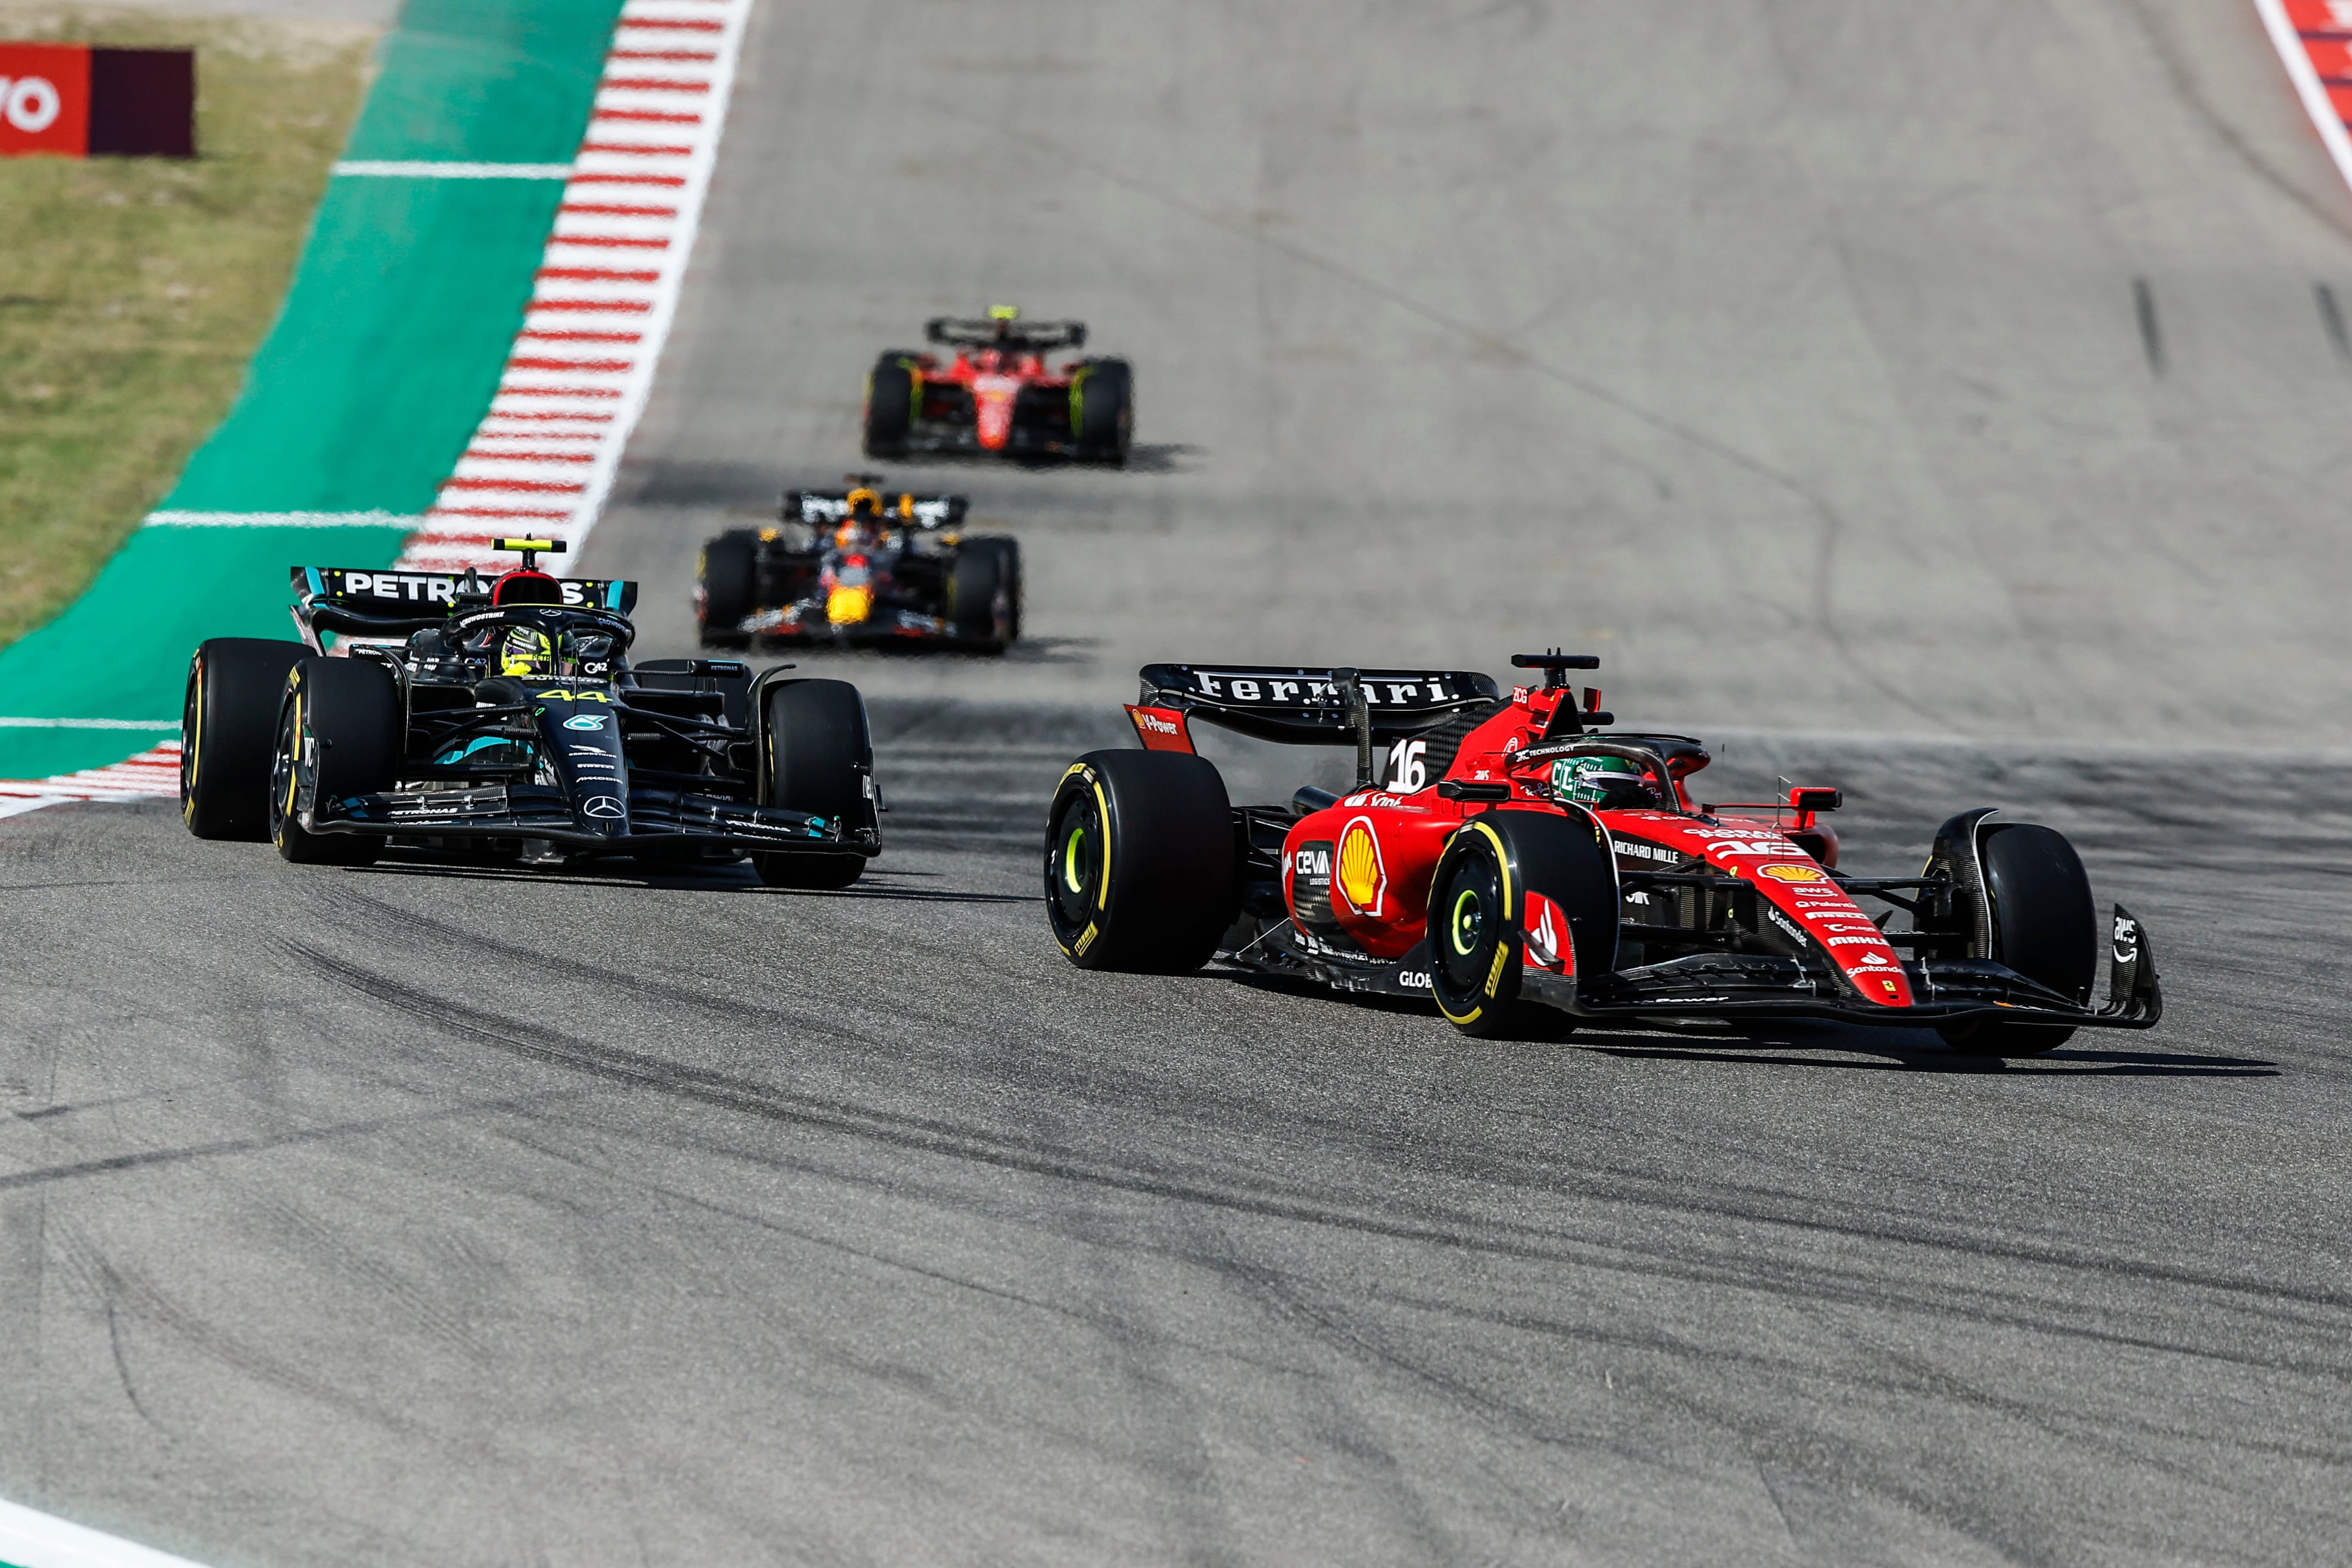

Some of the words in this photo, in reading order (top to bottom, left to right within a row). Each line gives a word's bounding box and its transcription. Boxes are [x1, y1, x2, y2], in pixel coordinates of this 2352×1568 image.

[346, 572, 584, 605] PETRS
[460, 611, 505, 628] CROWDSTRIKE
[1193, 670, 1449, 703] Ferrari
[536, 689, 613, 703] 44
[1141, 713, 1178, 735] V-Power
[1529, 745, 1576, 757] TECHNOLOGY
[1385, 738, 1426, 794] 16
[389, 807, 459, 815] PETRONAS
[725, 820, 791, 833] PETRONAS
[1613, 840, 1652, 859] RICHARD
[1652, 847, 1679, 864] MILLE
[1706, 841, 1811, 860] 16
[1812, 901, 1858, 909] Palantir
[1804, 911, 1869, 920] PIRELLI
[1775, 911, 1808, 948] Santander
